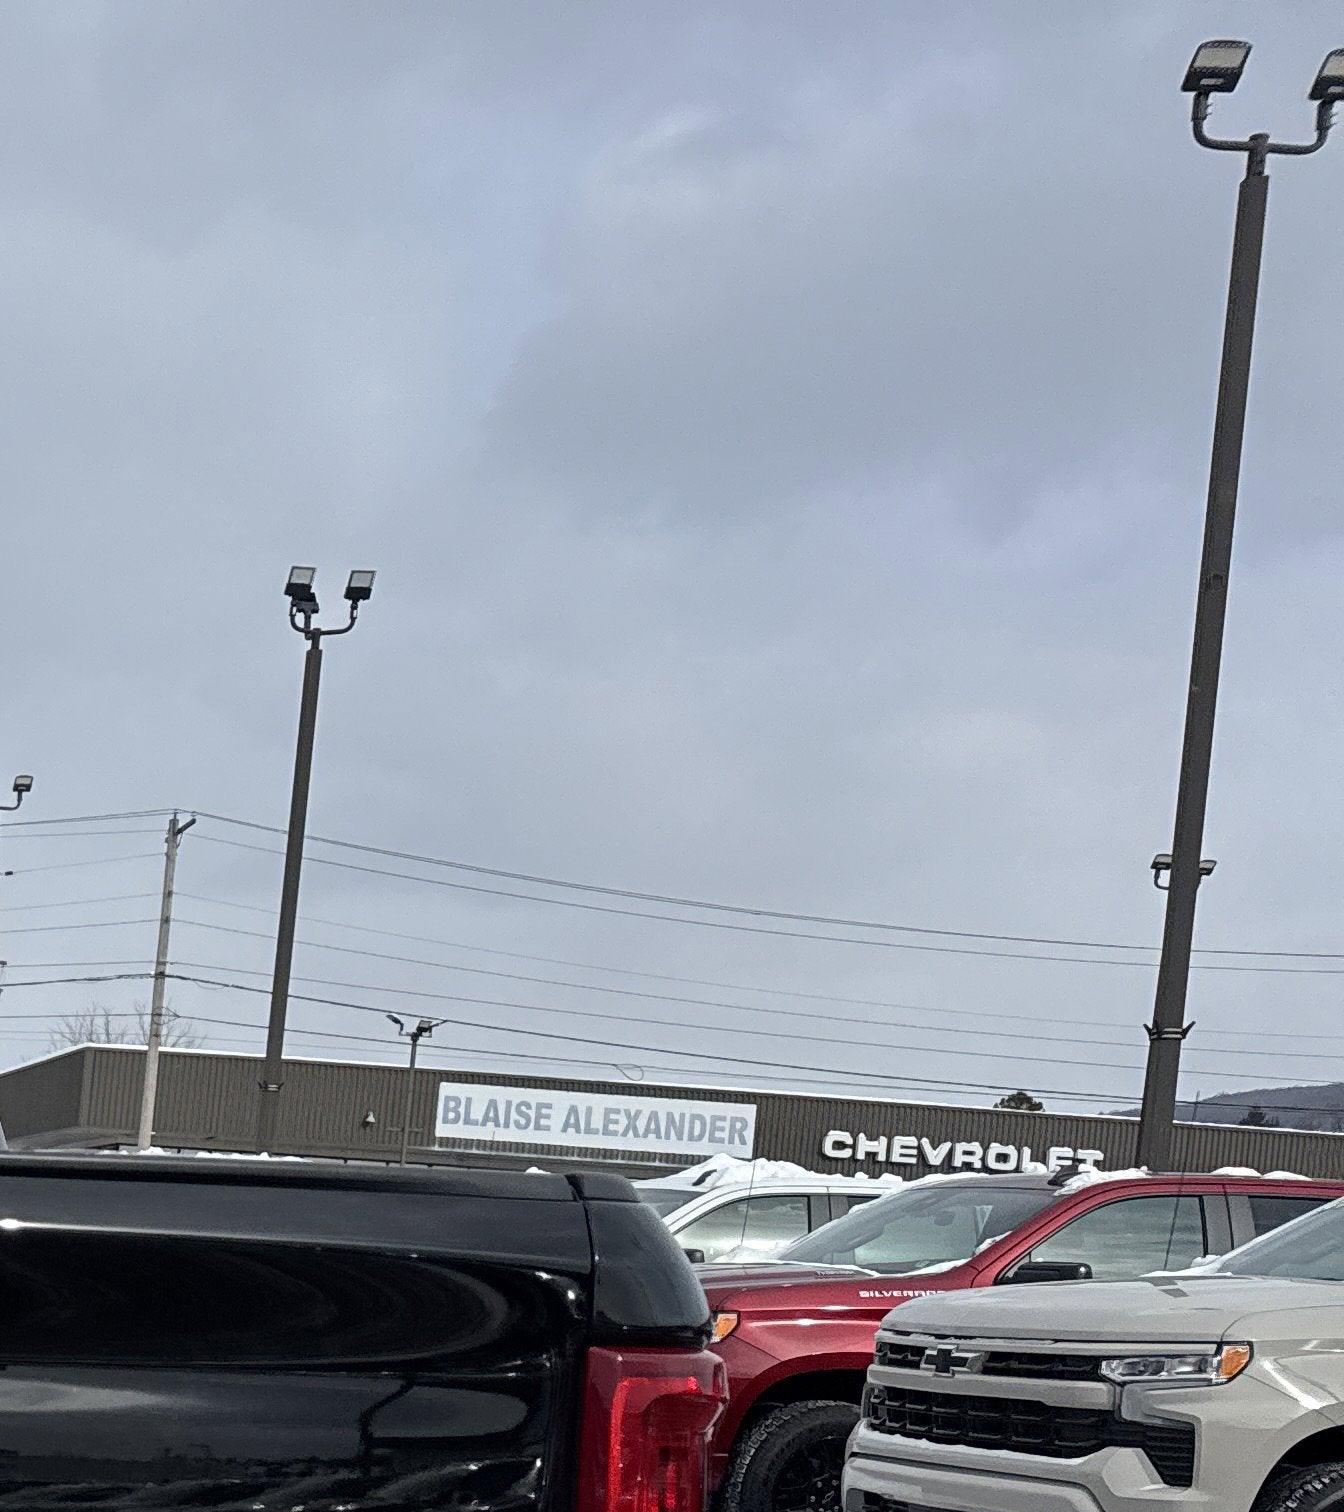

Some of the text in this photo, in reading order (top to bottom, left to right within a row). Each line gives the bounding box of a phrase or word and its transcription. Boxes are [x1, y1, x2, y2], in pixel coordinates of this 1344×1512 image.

[441, 1095, 749, 1146] BLAISE ALEXANDER
[821, 1130, 1105, 1174] CHEVROLET
